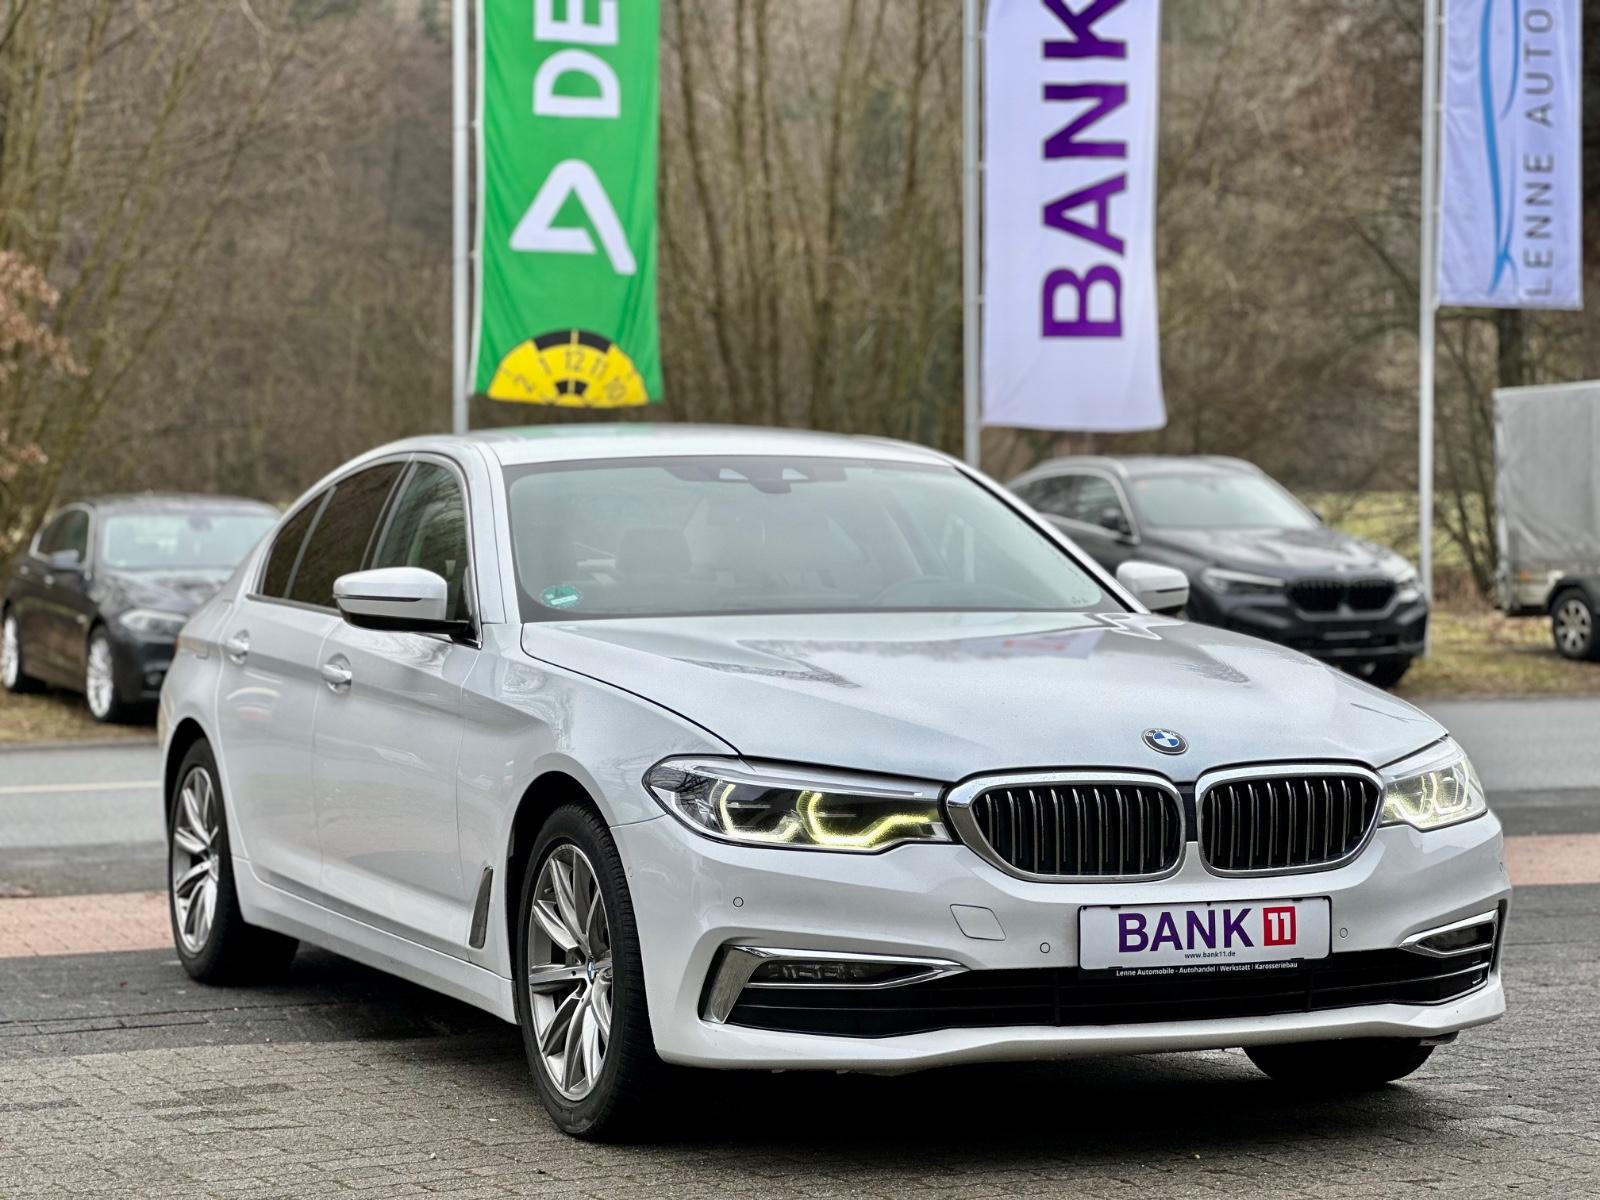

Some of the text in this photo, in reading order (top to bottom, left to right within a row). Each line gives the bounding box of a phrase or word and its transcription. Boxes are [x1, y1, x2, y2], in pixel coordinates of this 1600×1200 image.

[1041, 0, 1128, 338] BANK
[1523, 9, 1553, 297] LENNE AUTO
[564, 350, 585, 372] 12
[1118, 908, 1292, 953] BANK 11
[1137, 967, 1175, 976] Automobile
[1179, 965, 1216, 974] Autohandel
[1220, 964, 1251, 972] Werkstatt
[1254, 961, 1298, 970] Karosseriebau
[1184, 950, 1236, 959] www.bank11.de
